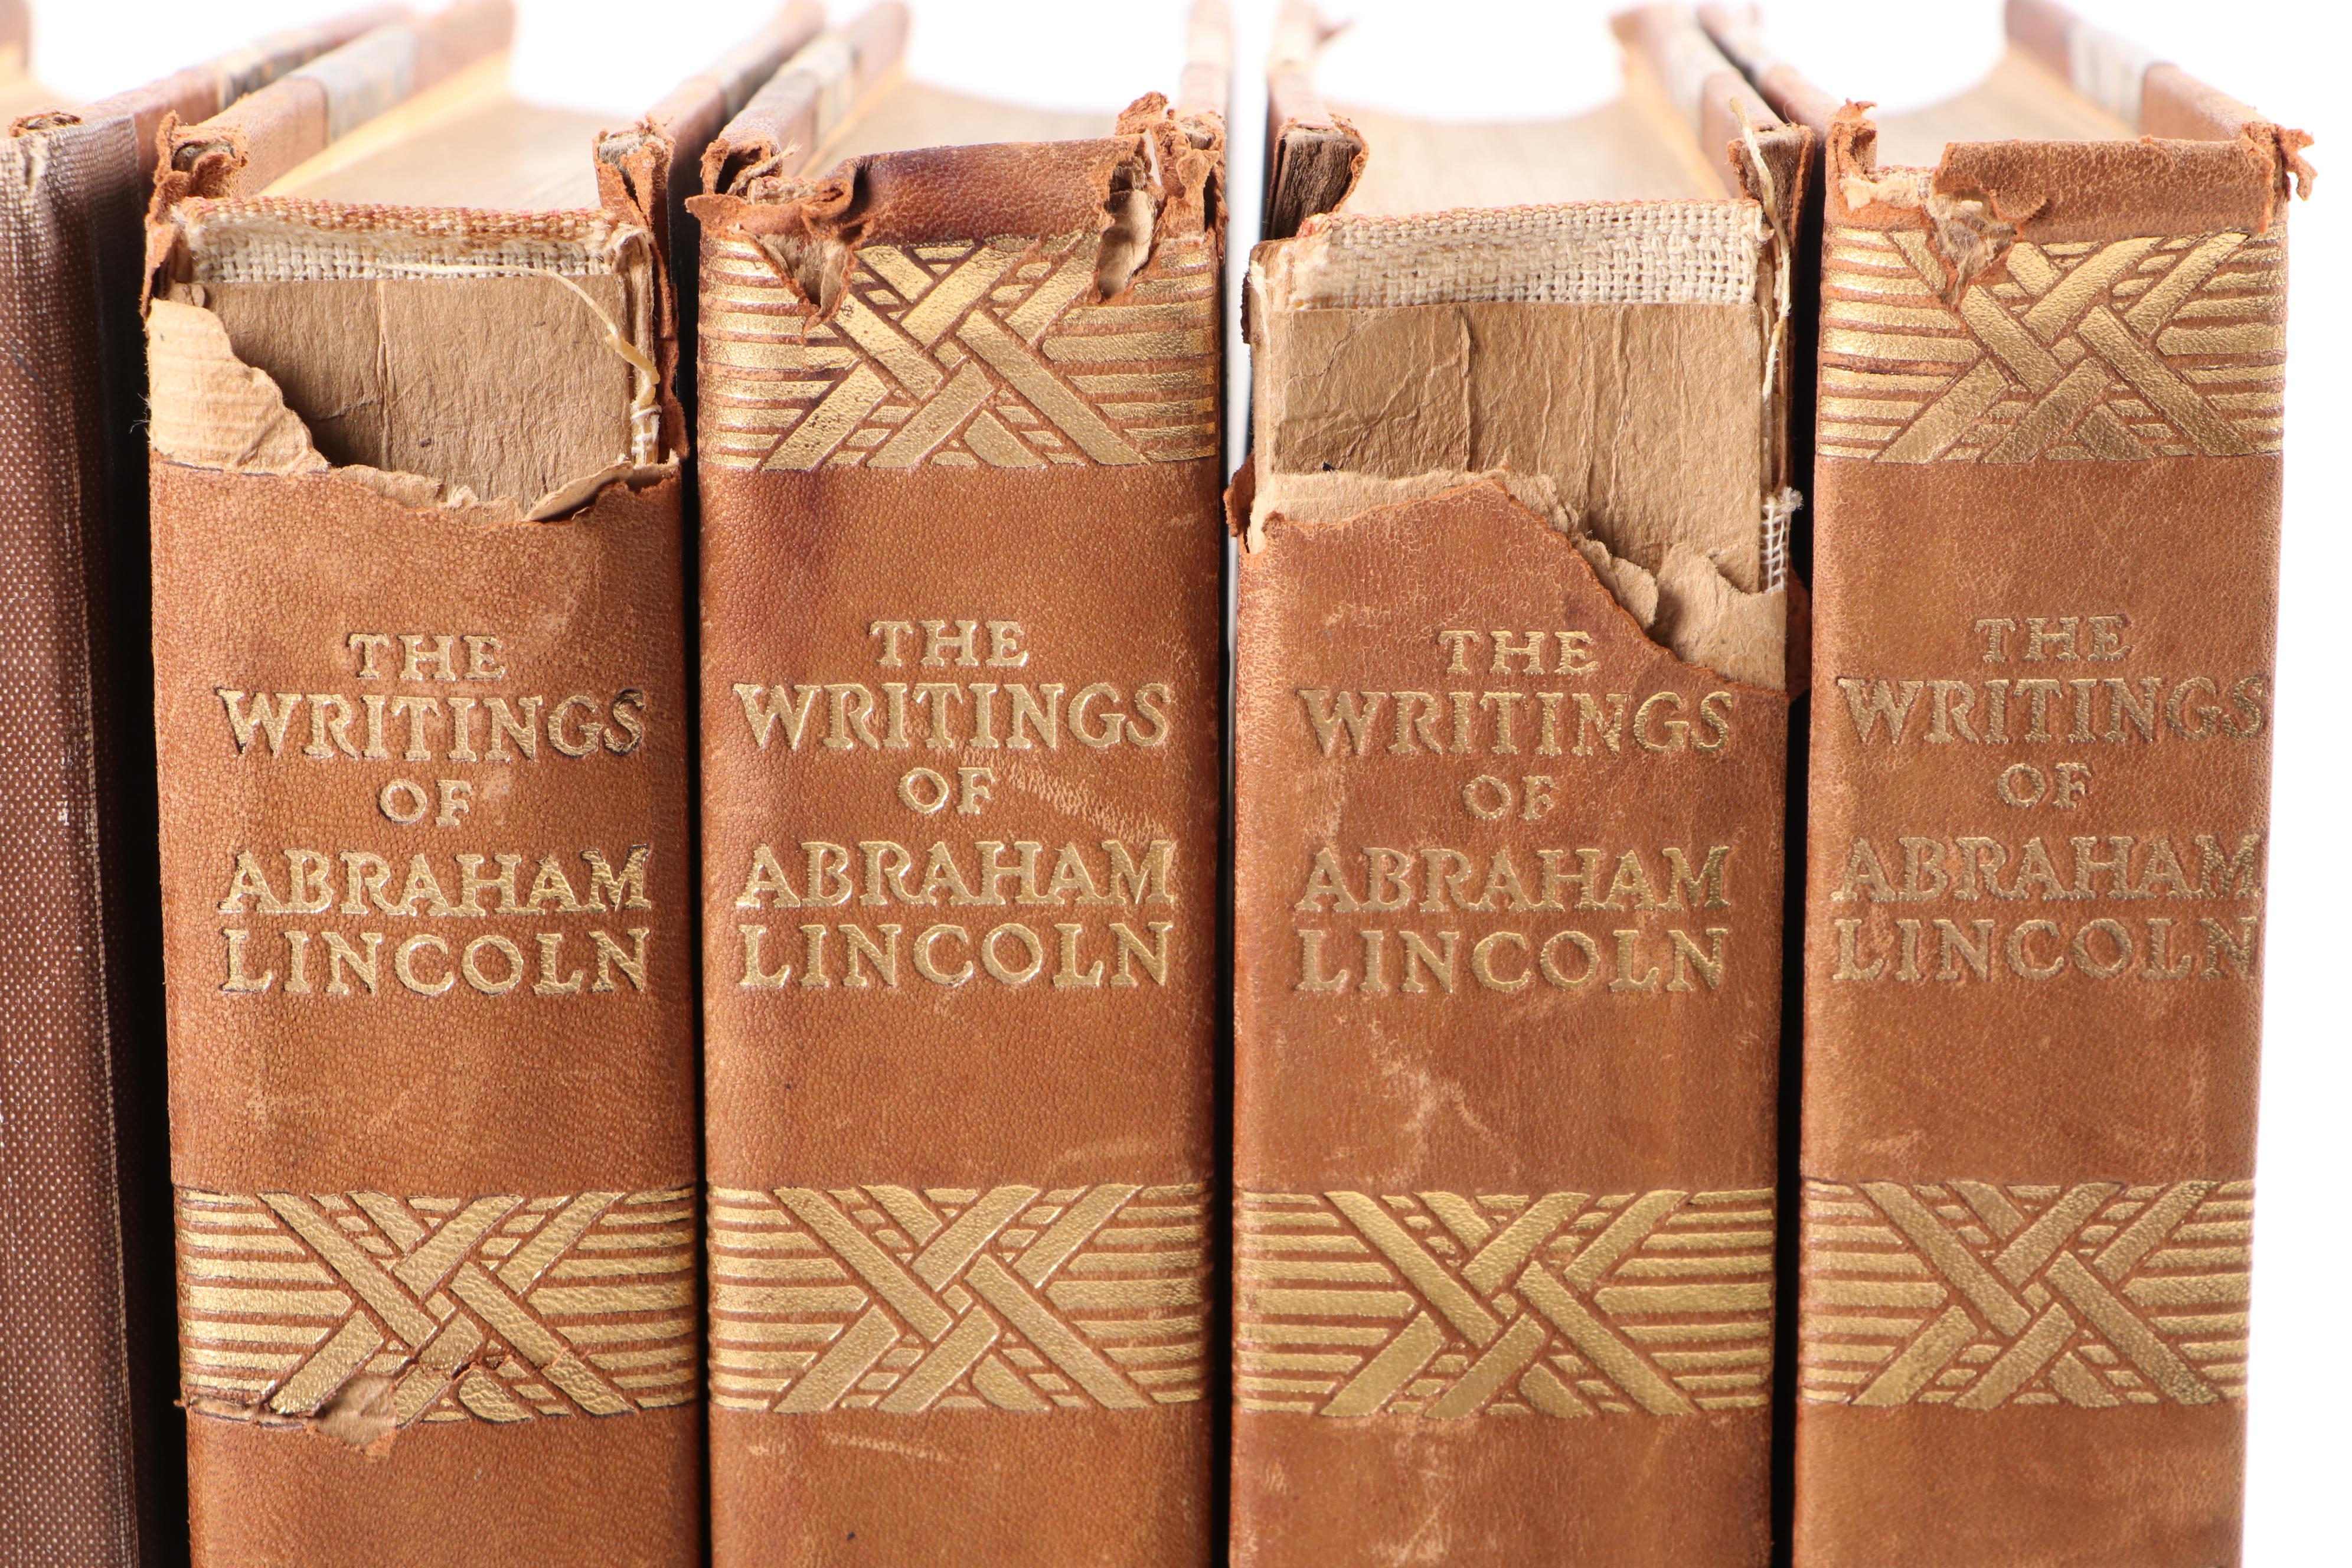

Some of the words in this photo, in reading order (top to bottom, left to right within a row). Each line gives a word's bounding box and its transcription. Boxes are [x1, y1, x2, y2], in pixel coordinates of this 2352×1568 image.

[348, 632, 505, 681] THE
[870, 619, 1028, 667] THE
[1438, 631, 1599, 675] THE
[1974, 614, 2135, 664] THE
[215, 688, 646, 762] WRITINGS
[733, 681, 1171, 750] WRITINGS
[1298, 690, 1733, 756] WRITINGS
[1836, 675, 2267, 744] WRITINGS
[378, 779, 472, 826] OF
[897, 767, 995, 815] OF
[1463, 774, 1557, 820] OF
[1996, 762, 2093, 809] OF
[218, 844, 652, 916] ABRAHAM
[735, 839, 1175, 909] ABRAHAM
[1295, 845, 1731, 912] ABRAHAM
[1831, 834, 2262, 903] ABRAHAM
[221, 926, 649, 995] LINCOLN
[738, 922, 1174, 988] LINCOLN
[1296, 927, 1729, 992] LINCOLN
[1832, 917, 2258, 981] LINCOLN
